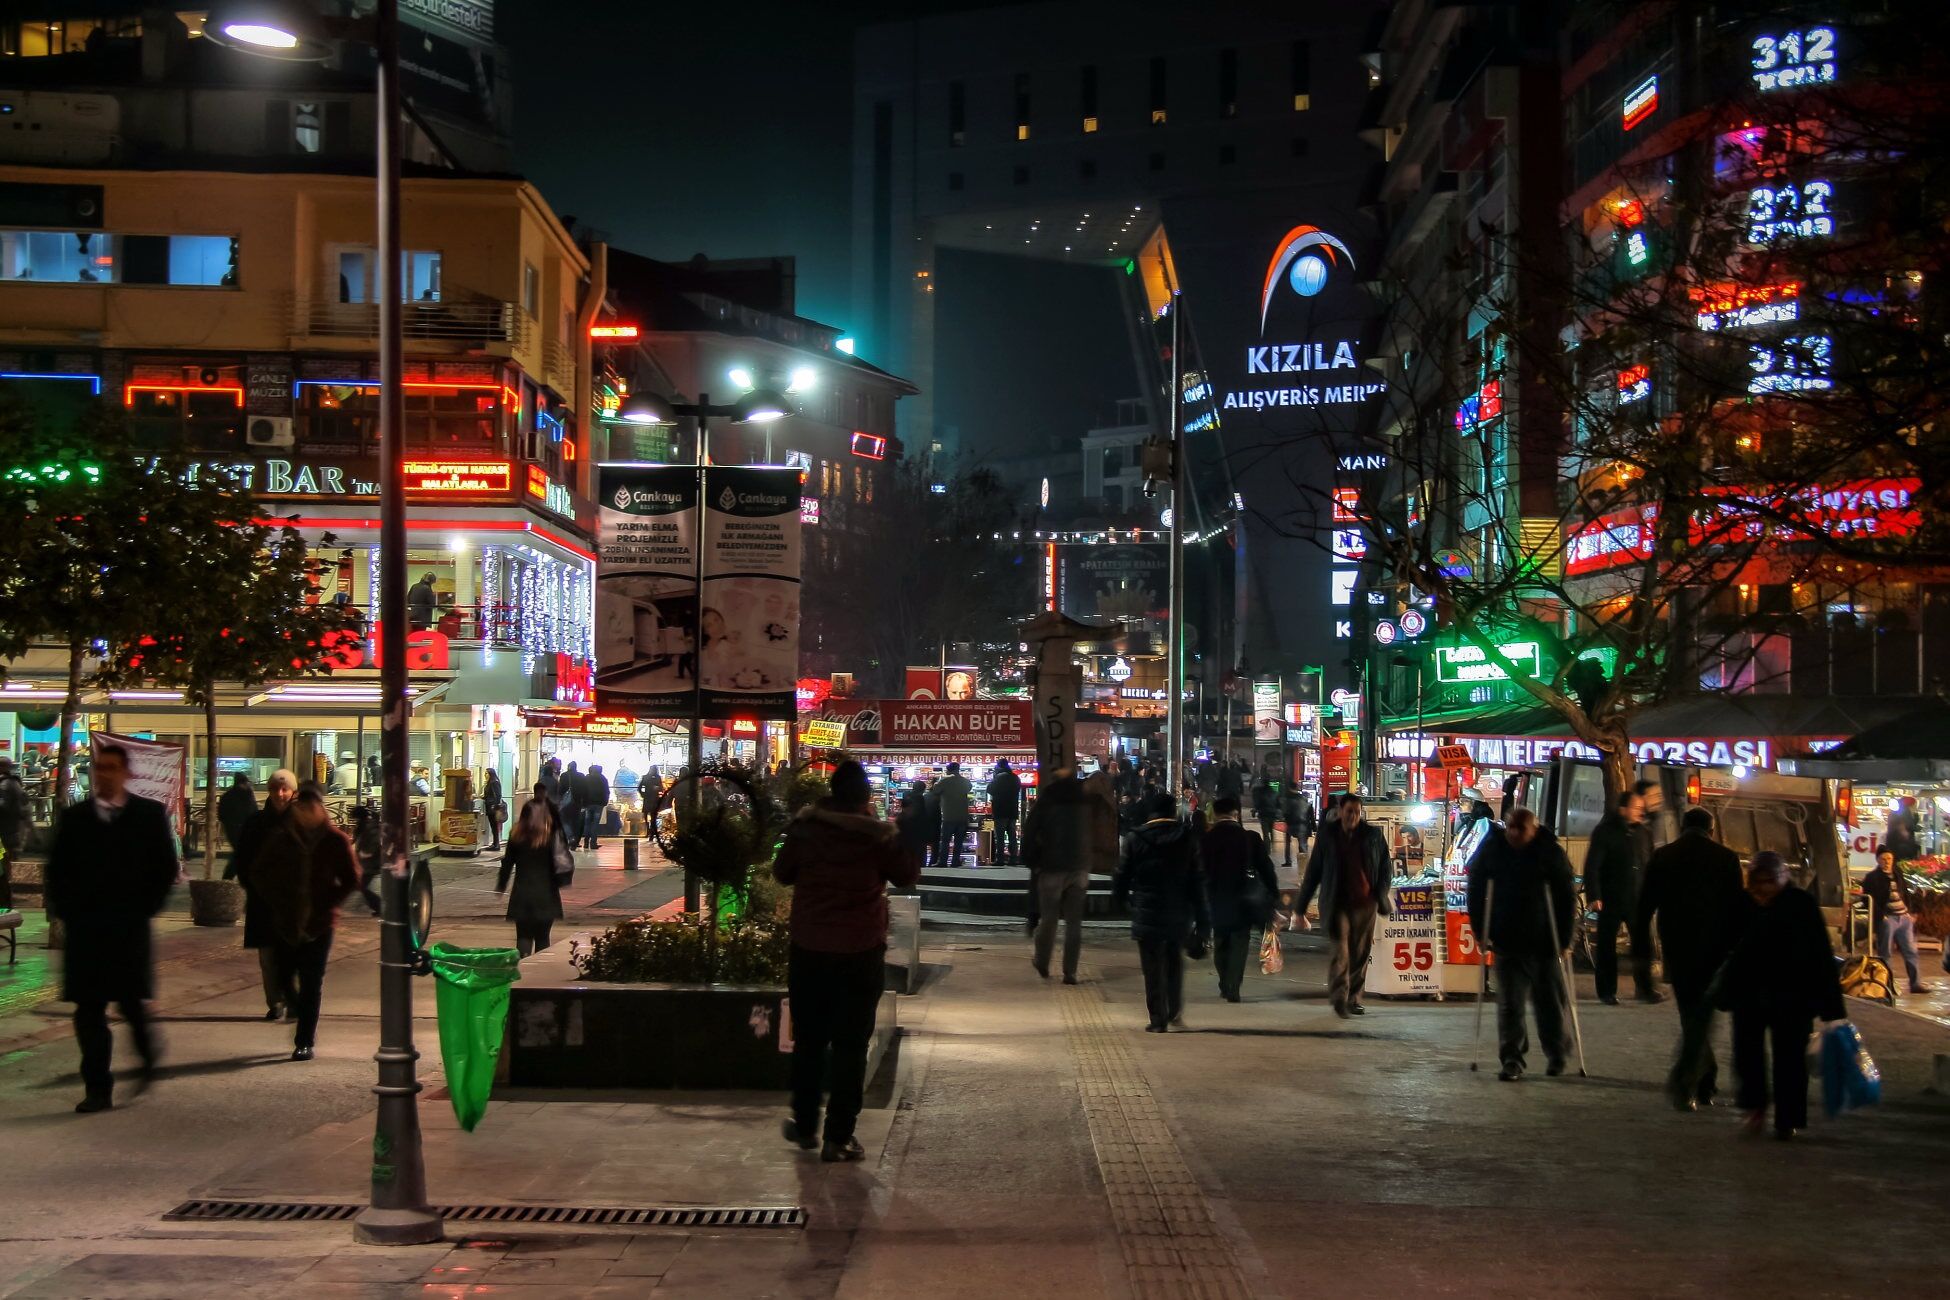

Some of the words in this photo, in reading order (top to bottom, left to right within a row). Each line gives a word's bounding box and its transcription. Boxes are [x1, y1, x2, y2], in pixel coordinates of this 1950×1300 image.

[1751, 29, 1834, 69] 312
[1247, 340, 1360, 373] KIZILA
[1223, 385, 1319, 411] ALIŞVERİŞ
[1336, 455, 1386, 471] MAN
[266, 459, 346, 494] BAR
[633, 490, 682, 504] Çankaya
[738, 493, 788, 506] Çankaya
[615, 522, 648, 531] YARIM
[651, 523, 679, 532] ELMA
[893, 714, 963, 731] HAKAN
[969, 710, 1021, 731] BÜFE
[894, 733, 909, 742] GSM
[992, 733, 1021, 742] TELEFON
[881, 754, 911, 764] PARÇA
[913, 753, 949, 763] KONTÖR
[960, 755, 983, 763] FAKS
[1439, 747, 1470, 760] VISA
[1384, 927, 1406, 939] SÜPER
[1393, 942, 1434, 971] 55
